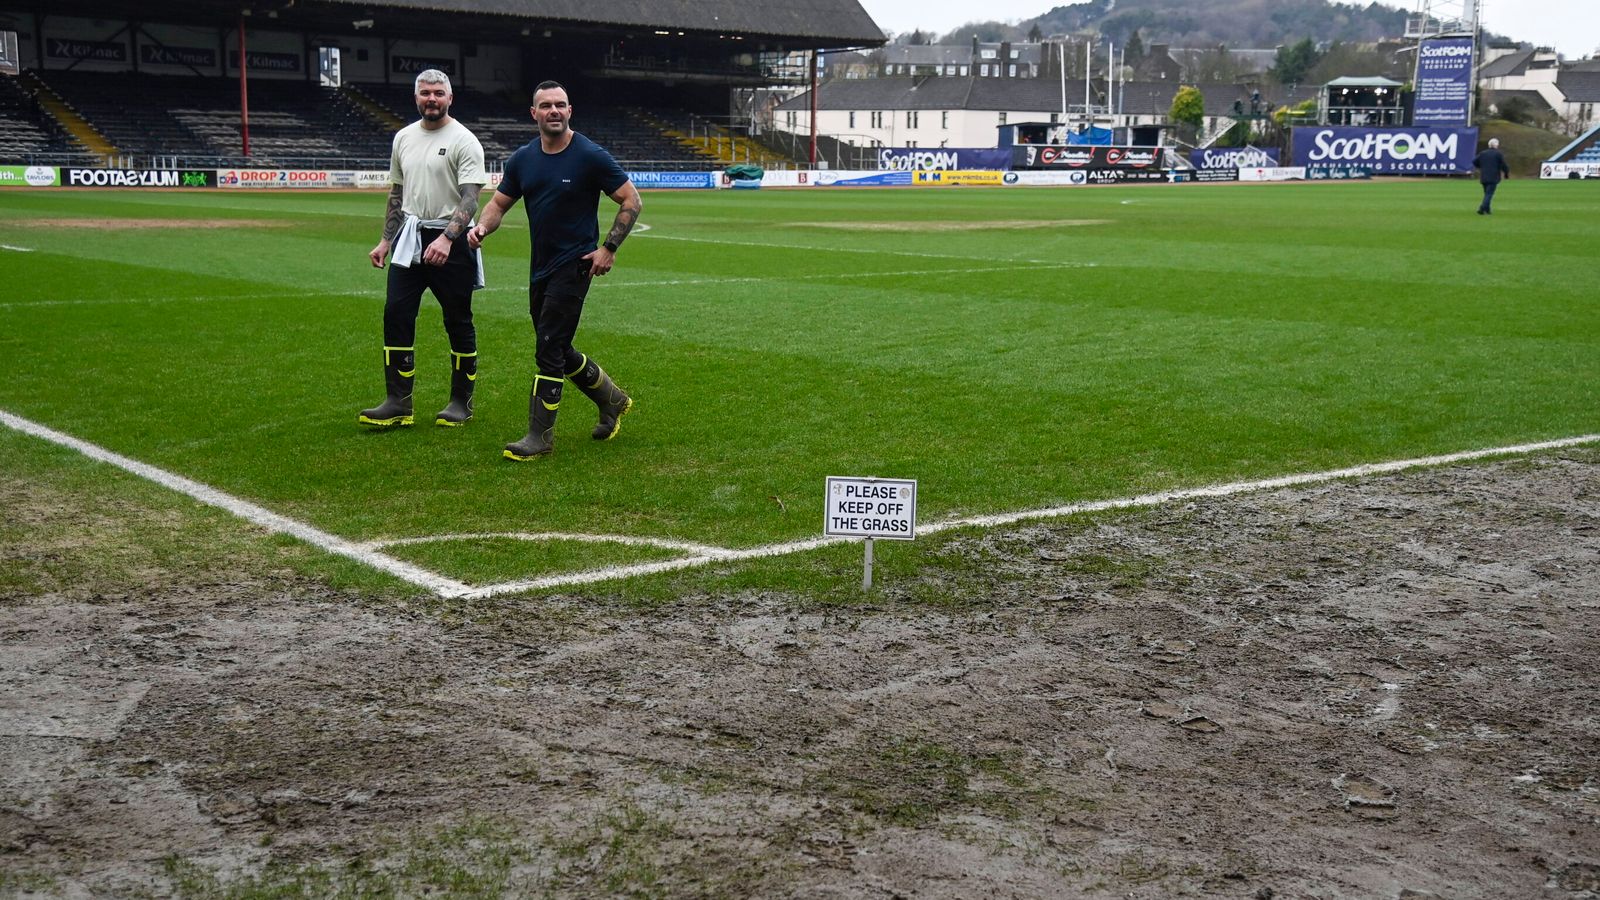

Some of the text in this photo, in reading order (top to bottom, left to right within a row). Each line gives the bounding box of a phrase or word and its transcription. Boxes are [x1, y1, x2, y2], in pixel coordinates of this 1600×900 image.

[1421, 46, 1471, 57] ScotFOAM
[1308, 130, 1458, 160] ScotFOAM
[879, 149, 958, 171] ScotFOAM
[1201, 150, 1267, 169] ScotFOAM
[70, 169, 179, 186] FOOTASYLUM
[241, 171, 327, 181] DROP 2 DOOR
[846, 486, 897, 499] PLEASE
[838, 501, 903, 515] KEEP OFF
[832, 517, 908, 532] THE GRASS
